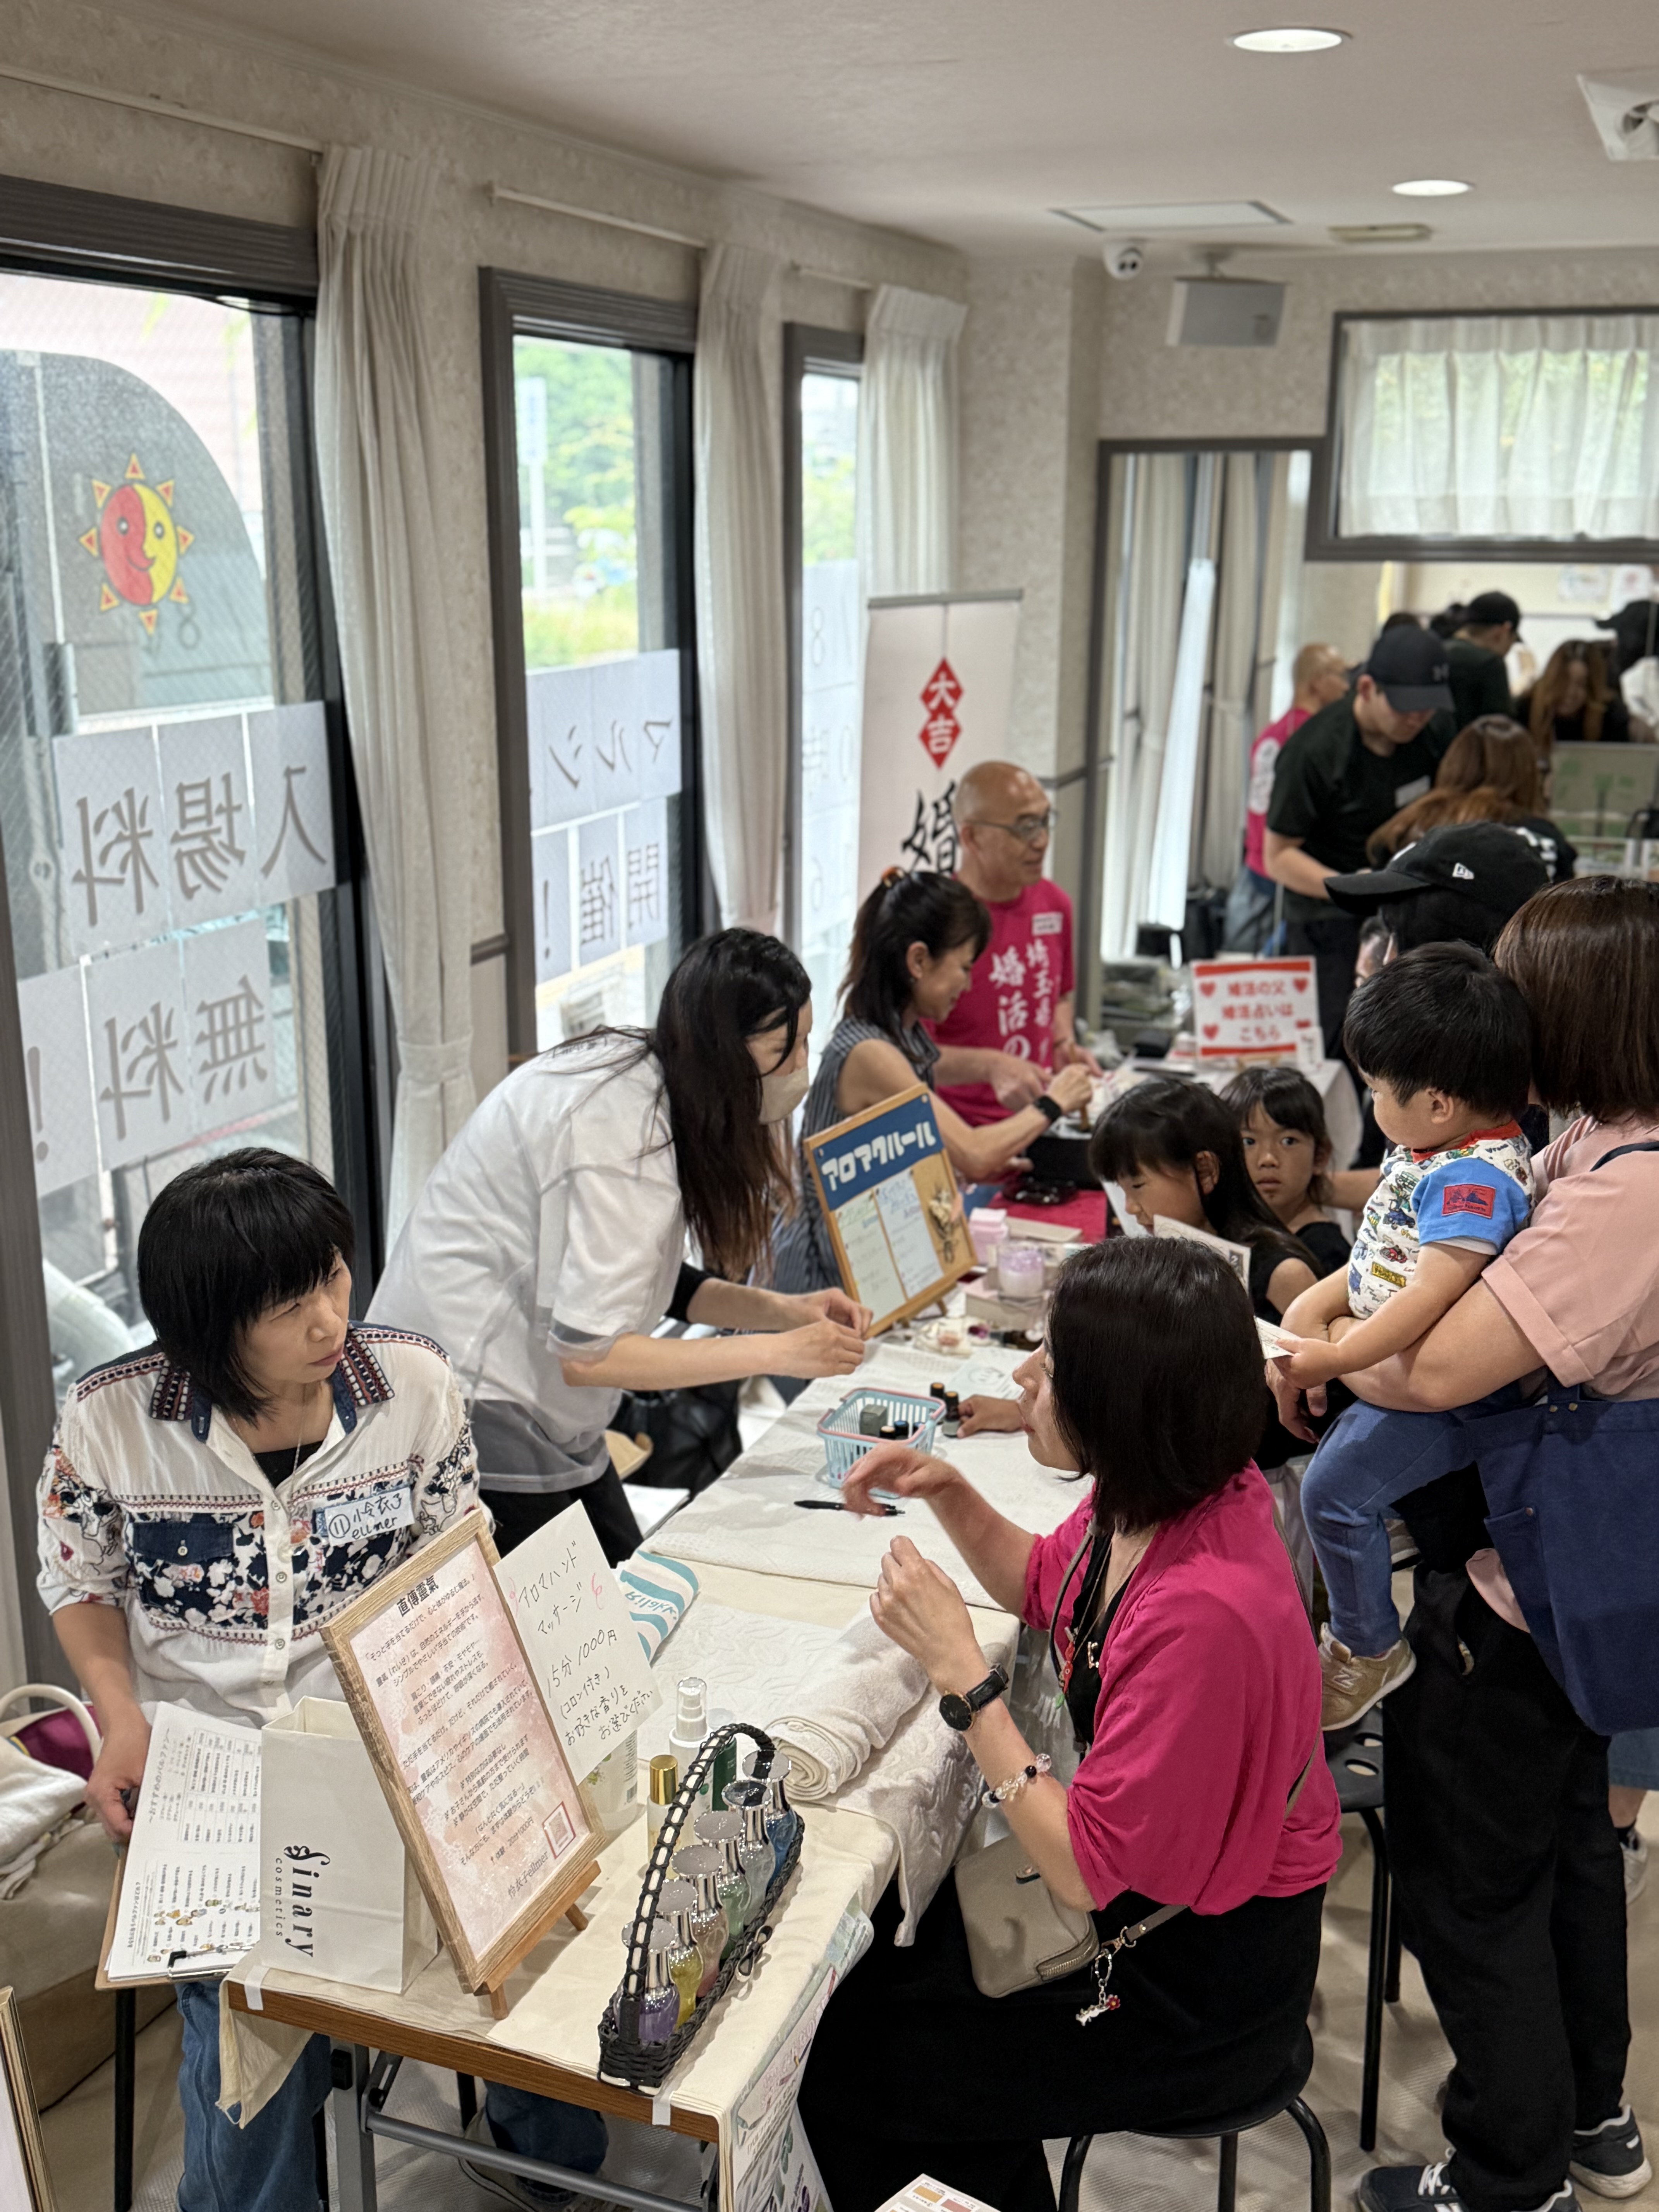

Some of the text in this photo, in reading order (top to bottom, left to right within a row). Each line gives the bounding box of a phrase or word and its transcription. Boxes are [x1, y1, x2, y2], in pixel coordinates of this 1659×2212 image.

[927, 671, 958, 755] 大吉
[1239, 1025, 1281, 1042] こちら
[821, 1121, 936, 1191] アロマクルール
[518, 1540, 578, 1608] アロマハンド
[537, 1583, 582, 1634] マッサージ
[578, 1629, 617, 1667] 1000円
[565, 1684, 629, 1746] お好きな香りを
[598, 1689, 654, 1740] お選びください
[275, 1857, 285, 1937] cosmetics
[283, 1845, 331, 1958] Sinary
